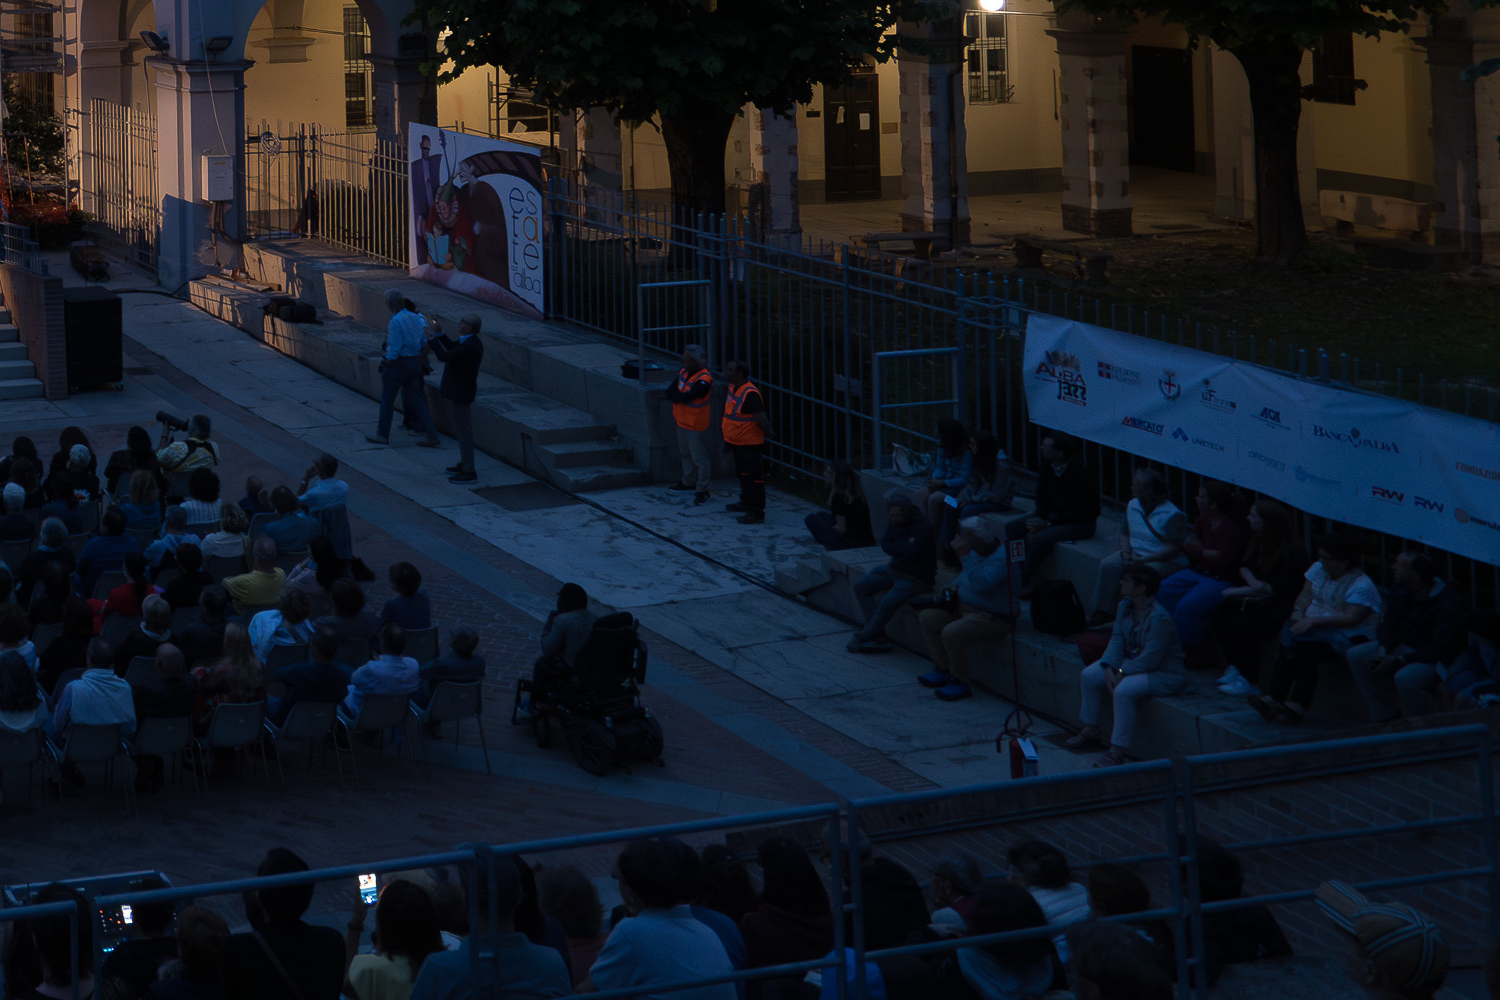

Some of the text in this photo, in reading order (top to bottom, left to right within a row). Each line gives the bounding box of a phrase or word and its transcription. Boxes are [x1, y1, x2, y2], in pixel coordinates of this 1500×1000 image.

[1035, 361, 1087, 386] ALBA
[1371, 485, 1445, 514] RW RW
